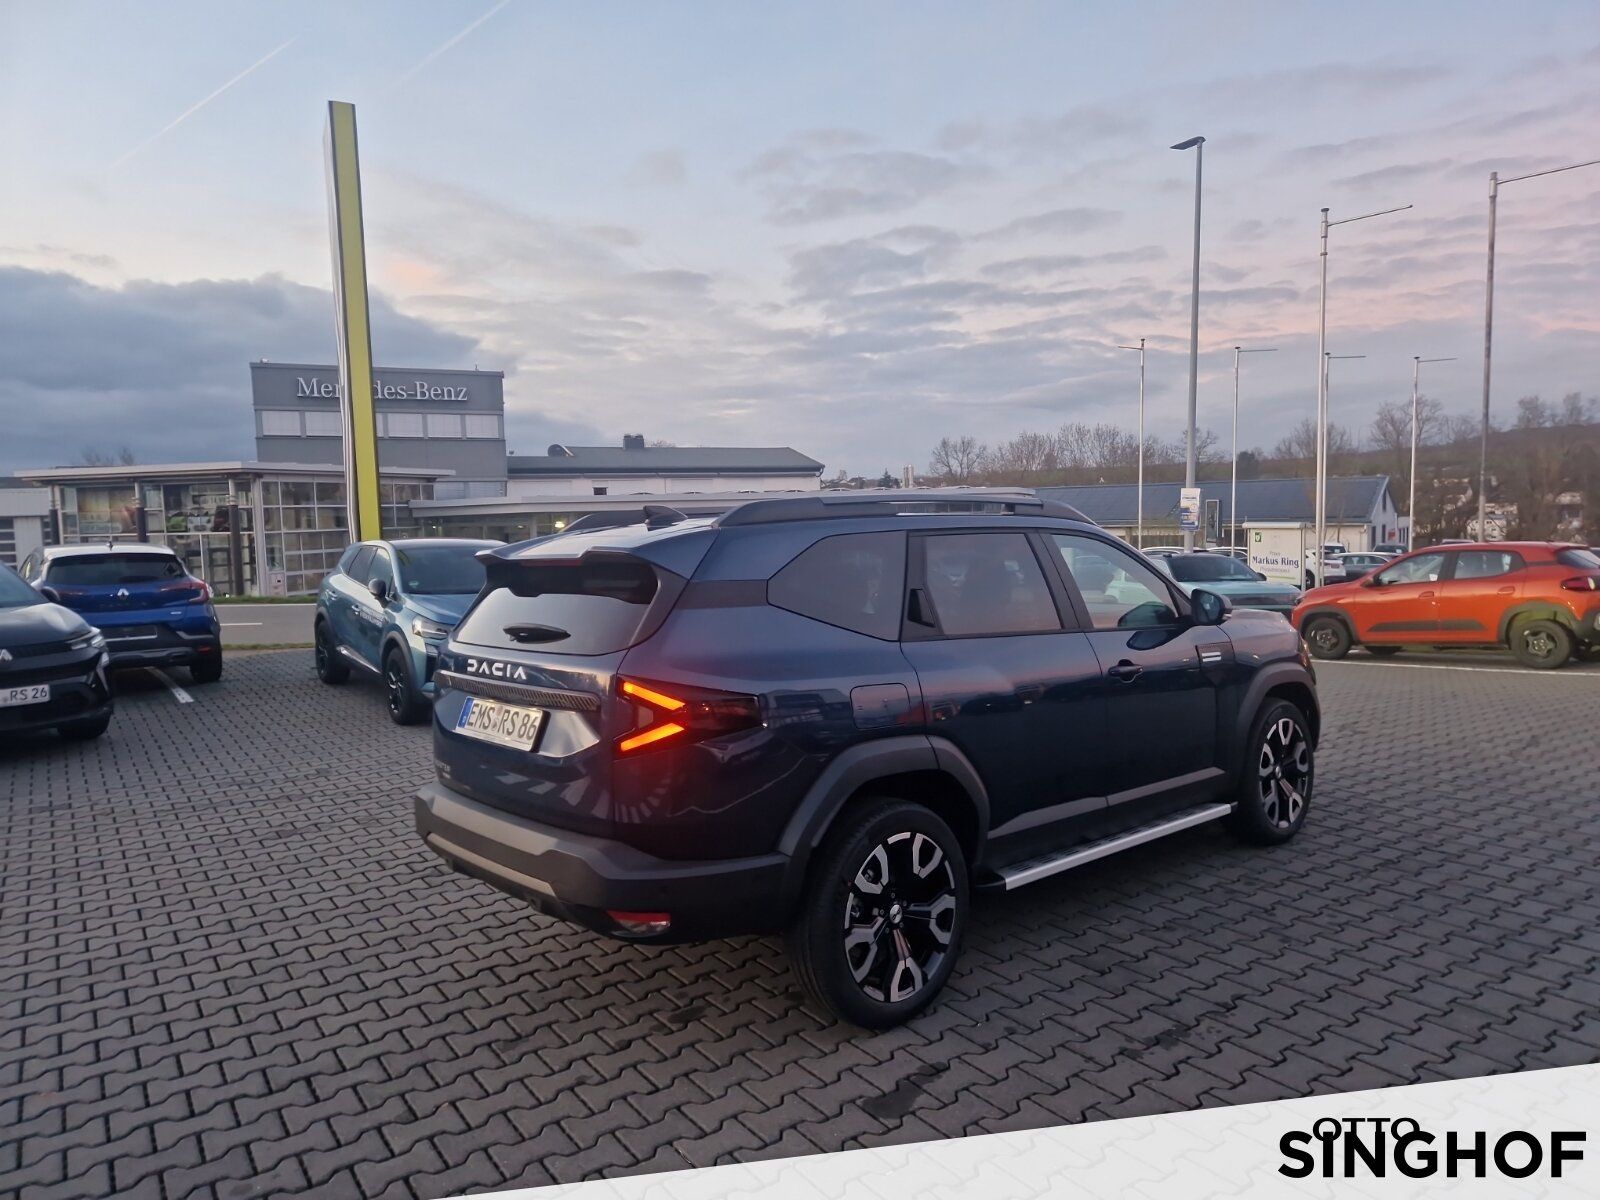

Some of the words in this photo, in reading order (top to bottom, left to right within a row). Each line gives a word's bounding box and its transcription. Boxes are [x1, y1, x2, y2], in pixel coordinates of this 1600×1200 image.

[297, 377, 468, 401] Merdes-Benz
[1252, 556, 1279, 565] Markus
[1281, 557, 1300, 568] Ring
[466, 659, 527, 680] DACIA
[10, 689, 28, 701] RS
[31, 687, 48, 699] 26
[466, 703, 495, 730] EMS
[498, 708, 520, 736] RS
[518, 713, 539, 740] 86
